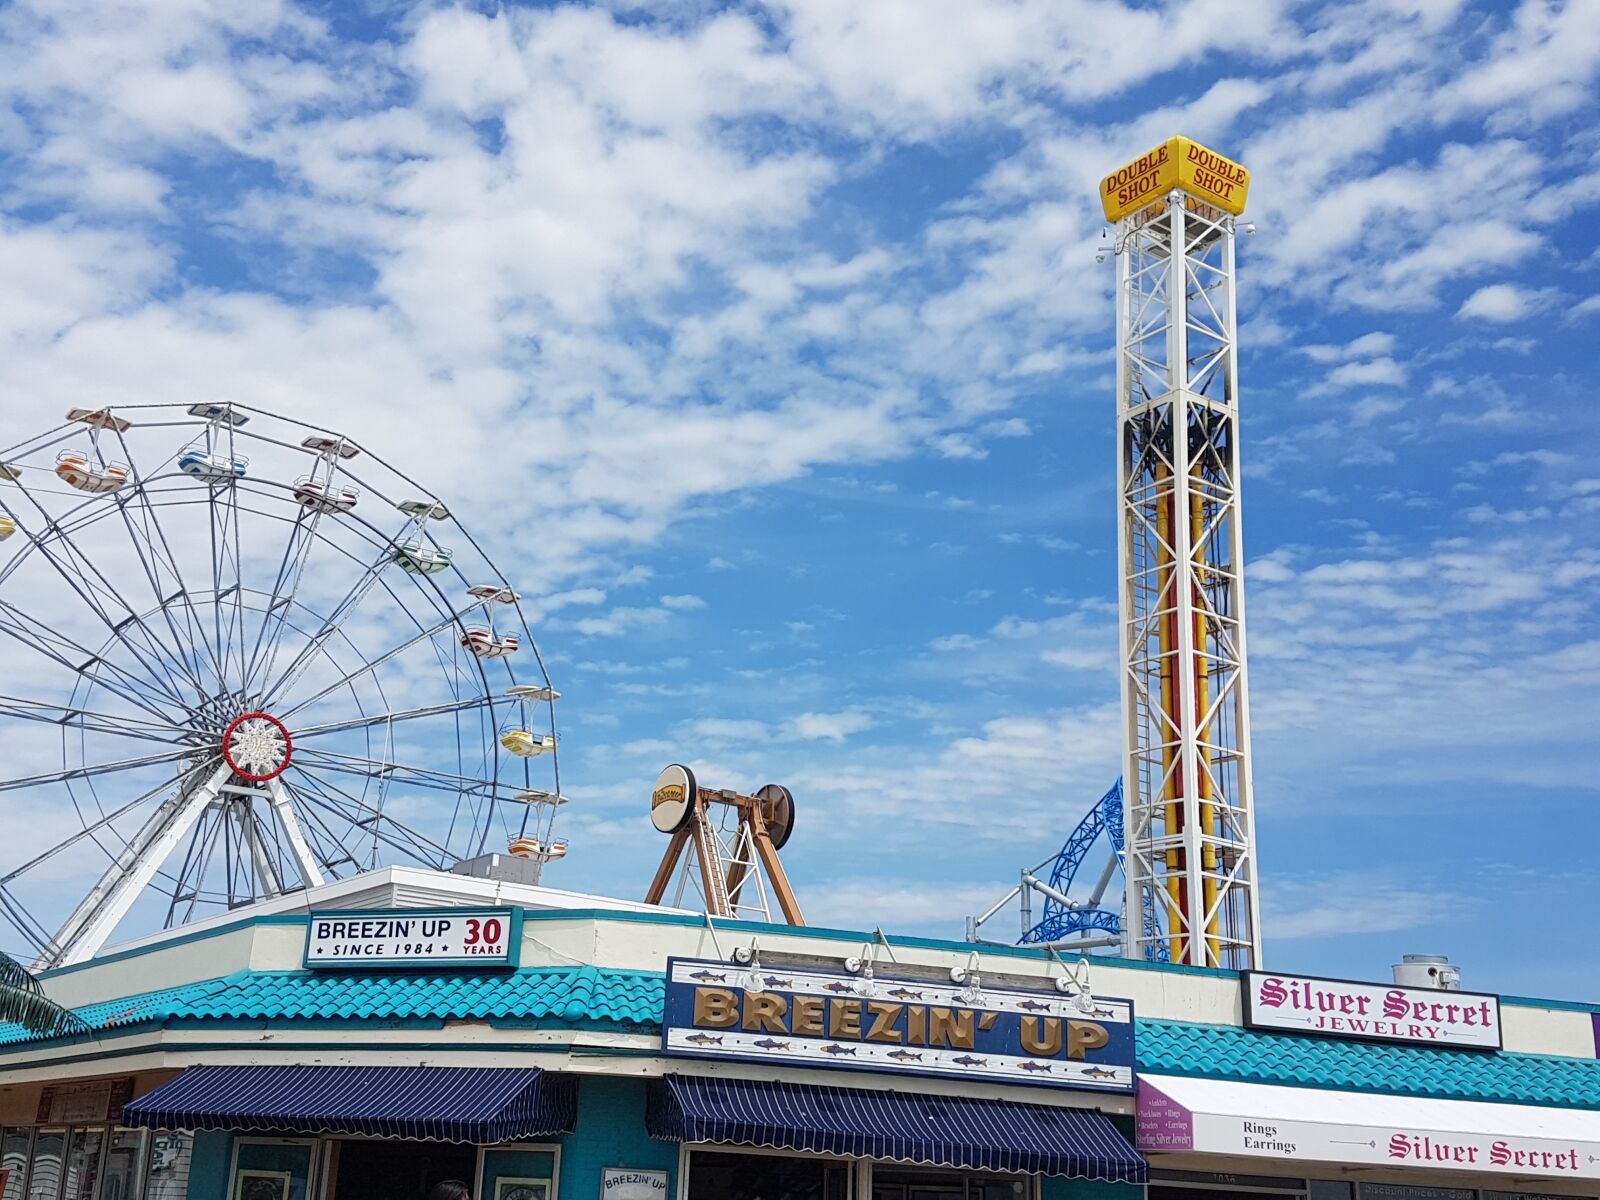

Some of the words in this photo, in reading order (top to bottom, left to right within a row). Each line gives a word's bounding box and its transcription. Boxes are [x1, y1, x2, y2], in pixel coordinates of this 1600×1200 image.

[1106, 146, 1169, 193] DOUBLE
[1187, 144, 1246, 185] DOUBLE
[1118, 170, 1161, 206] SHOT
[1193, 168, 1234, 198] SHOT
[317, 920, 415, 939] BREEZIN'
[422, 920, 451, 938] UP
[463, 918, 502, 945] 30
[332, 944, 385, 956] SINCE
[394, 943, 434, 955] 1984
[463, 945, 502, 955] YEARS
[1260, 977, 1371, 1016] Silver
[1382, 990, 1493, 1028] Secret
[693, 985, 998, 1050] BREEZIN'
[1019, 1015, 1109, 1060] UP
[1315, 1015, 1441, 1039] JEWELRY
[1168, 1121, 1188, 1130] Earrings
[1243, 1121, 1278, 1137] Rings
[1156, 1133, 1171, 1145] Silver
[1171, 1133, 1191, 1147] Jewelry
[1244, 1137, 1297, 1154] Earrings
[1388, 1133, 1479, 1163] Silver
[1490, 1141, 1579, 1171] Secret
[605, 1174, 652, 1190] BREEZIN'
[652, 1178, 666, 1191] UP
[1365, 1184, 1405, 1197] Discount
[1448, 1190, 1472, 1199] Gold
